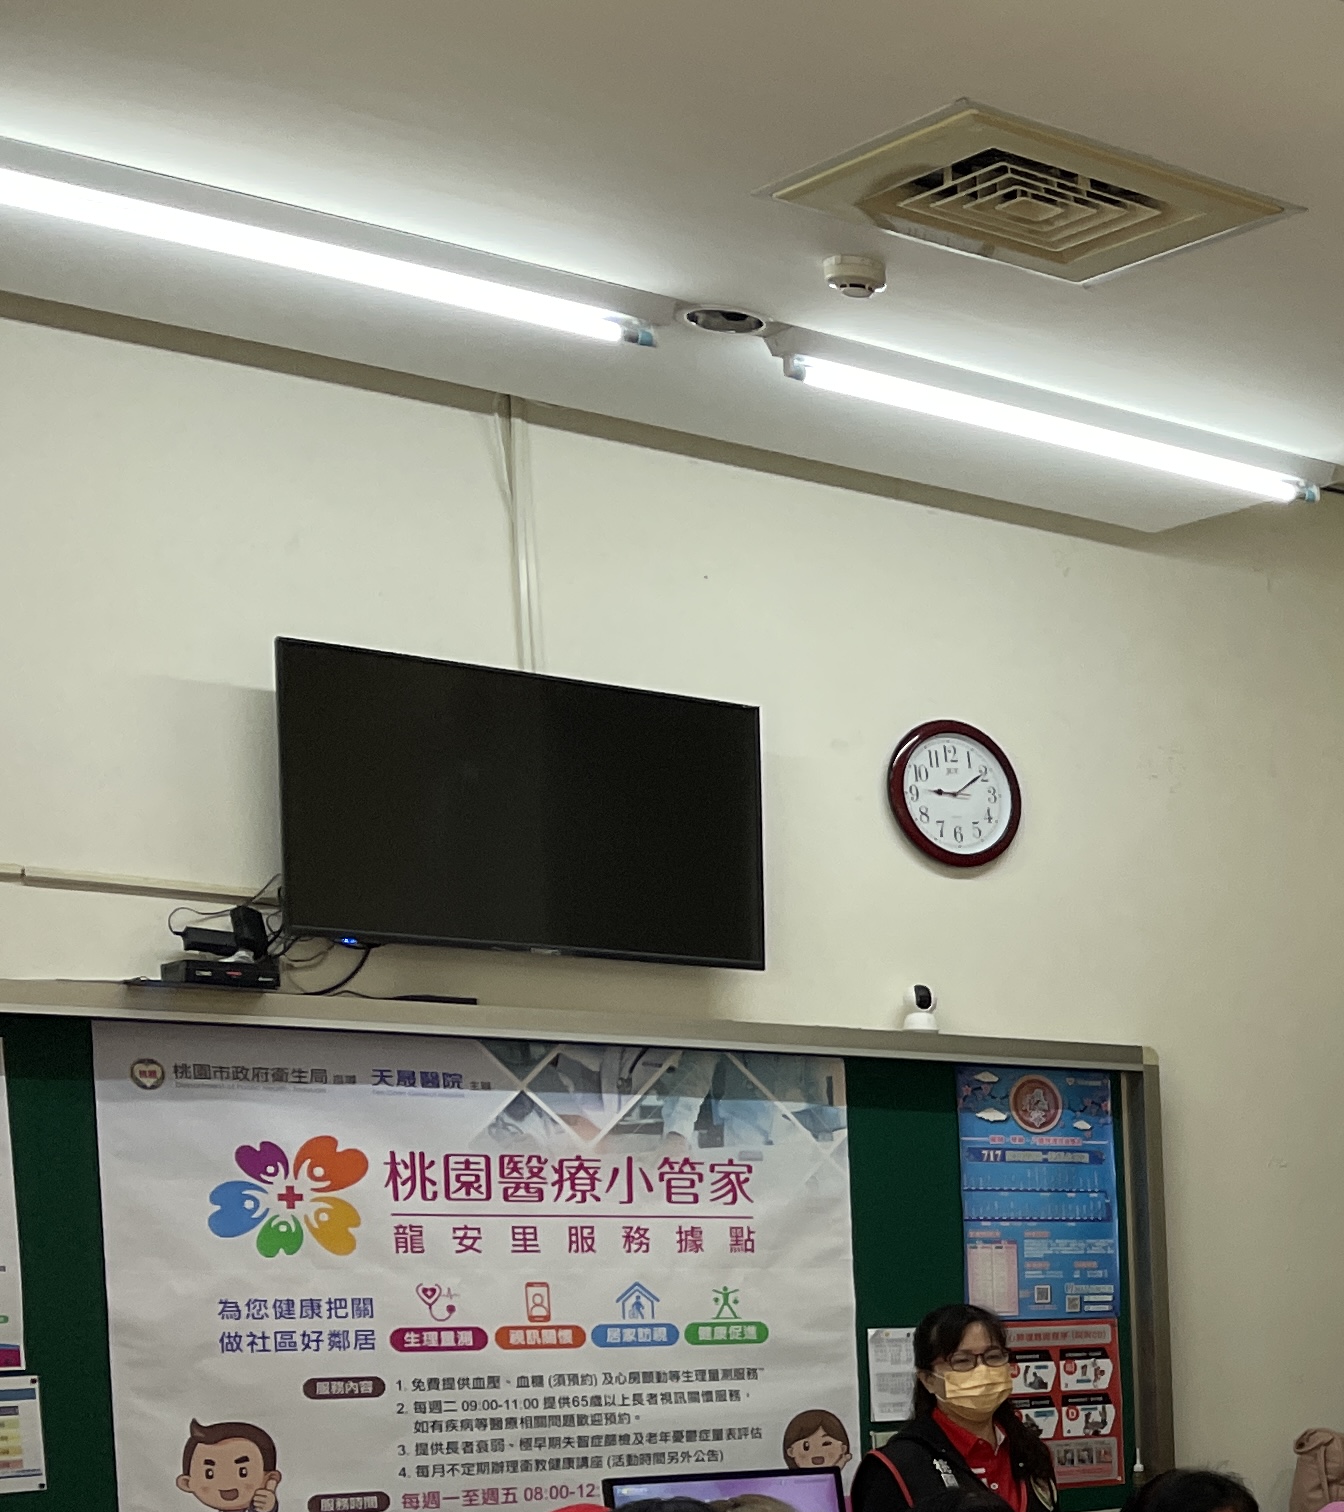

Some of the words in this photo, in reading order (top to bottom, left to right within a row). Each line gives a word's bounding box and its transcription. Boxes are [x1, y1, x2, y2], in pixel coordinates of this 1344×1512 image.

[928, 749, 939, 768] 11
[943, 745, 958, 762] 12
[966, 750, 972, 769] 1
[913, 764, 929, 782] 10
[978, 765, 989, 782] 2
[909, 784, 919, 802] 9
[987, 786, 997, 804] 3
[919, 805, 930, 824] 8
[984, 807, 993, 824] 4
[936, 820, 944, 837] 7
[953, 826, 963, 843] 6
[972, 821, 982, 839] 5
[173, 1063, 328, 1084] 桃園市政府衛生局
[371, 1068, 464, 1089] 天晟醫院
[981, 1150, 1002, 1162] 717
[384, 1150, 754, 1205] 桃園醫療小管家
[393, 1223, 756, 1254] 龍安里服務據點
[217, 1297, 375, 1320] 為您健康把關
[218, 1329, 376, 1353] 做社區好鄰居
[403, 1330, 474, 1348] 生理量測
[316, 1381, 373, 1395] 服務內容
[396, 1380, 407, 1391] 1.
[396, 1403, 408, 1415] 2.
[413, 1399, 458, 1415] 每週二
[461, 1398, 539, 1412] 09:00-11:00
[1069, 1409, 1076, 1418] D
[397, 1445, 410, 1456] 3.
[398, 1467, 411, 1478] 4.
[402, 1487, 518, 1510] 每週一至週五
